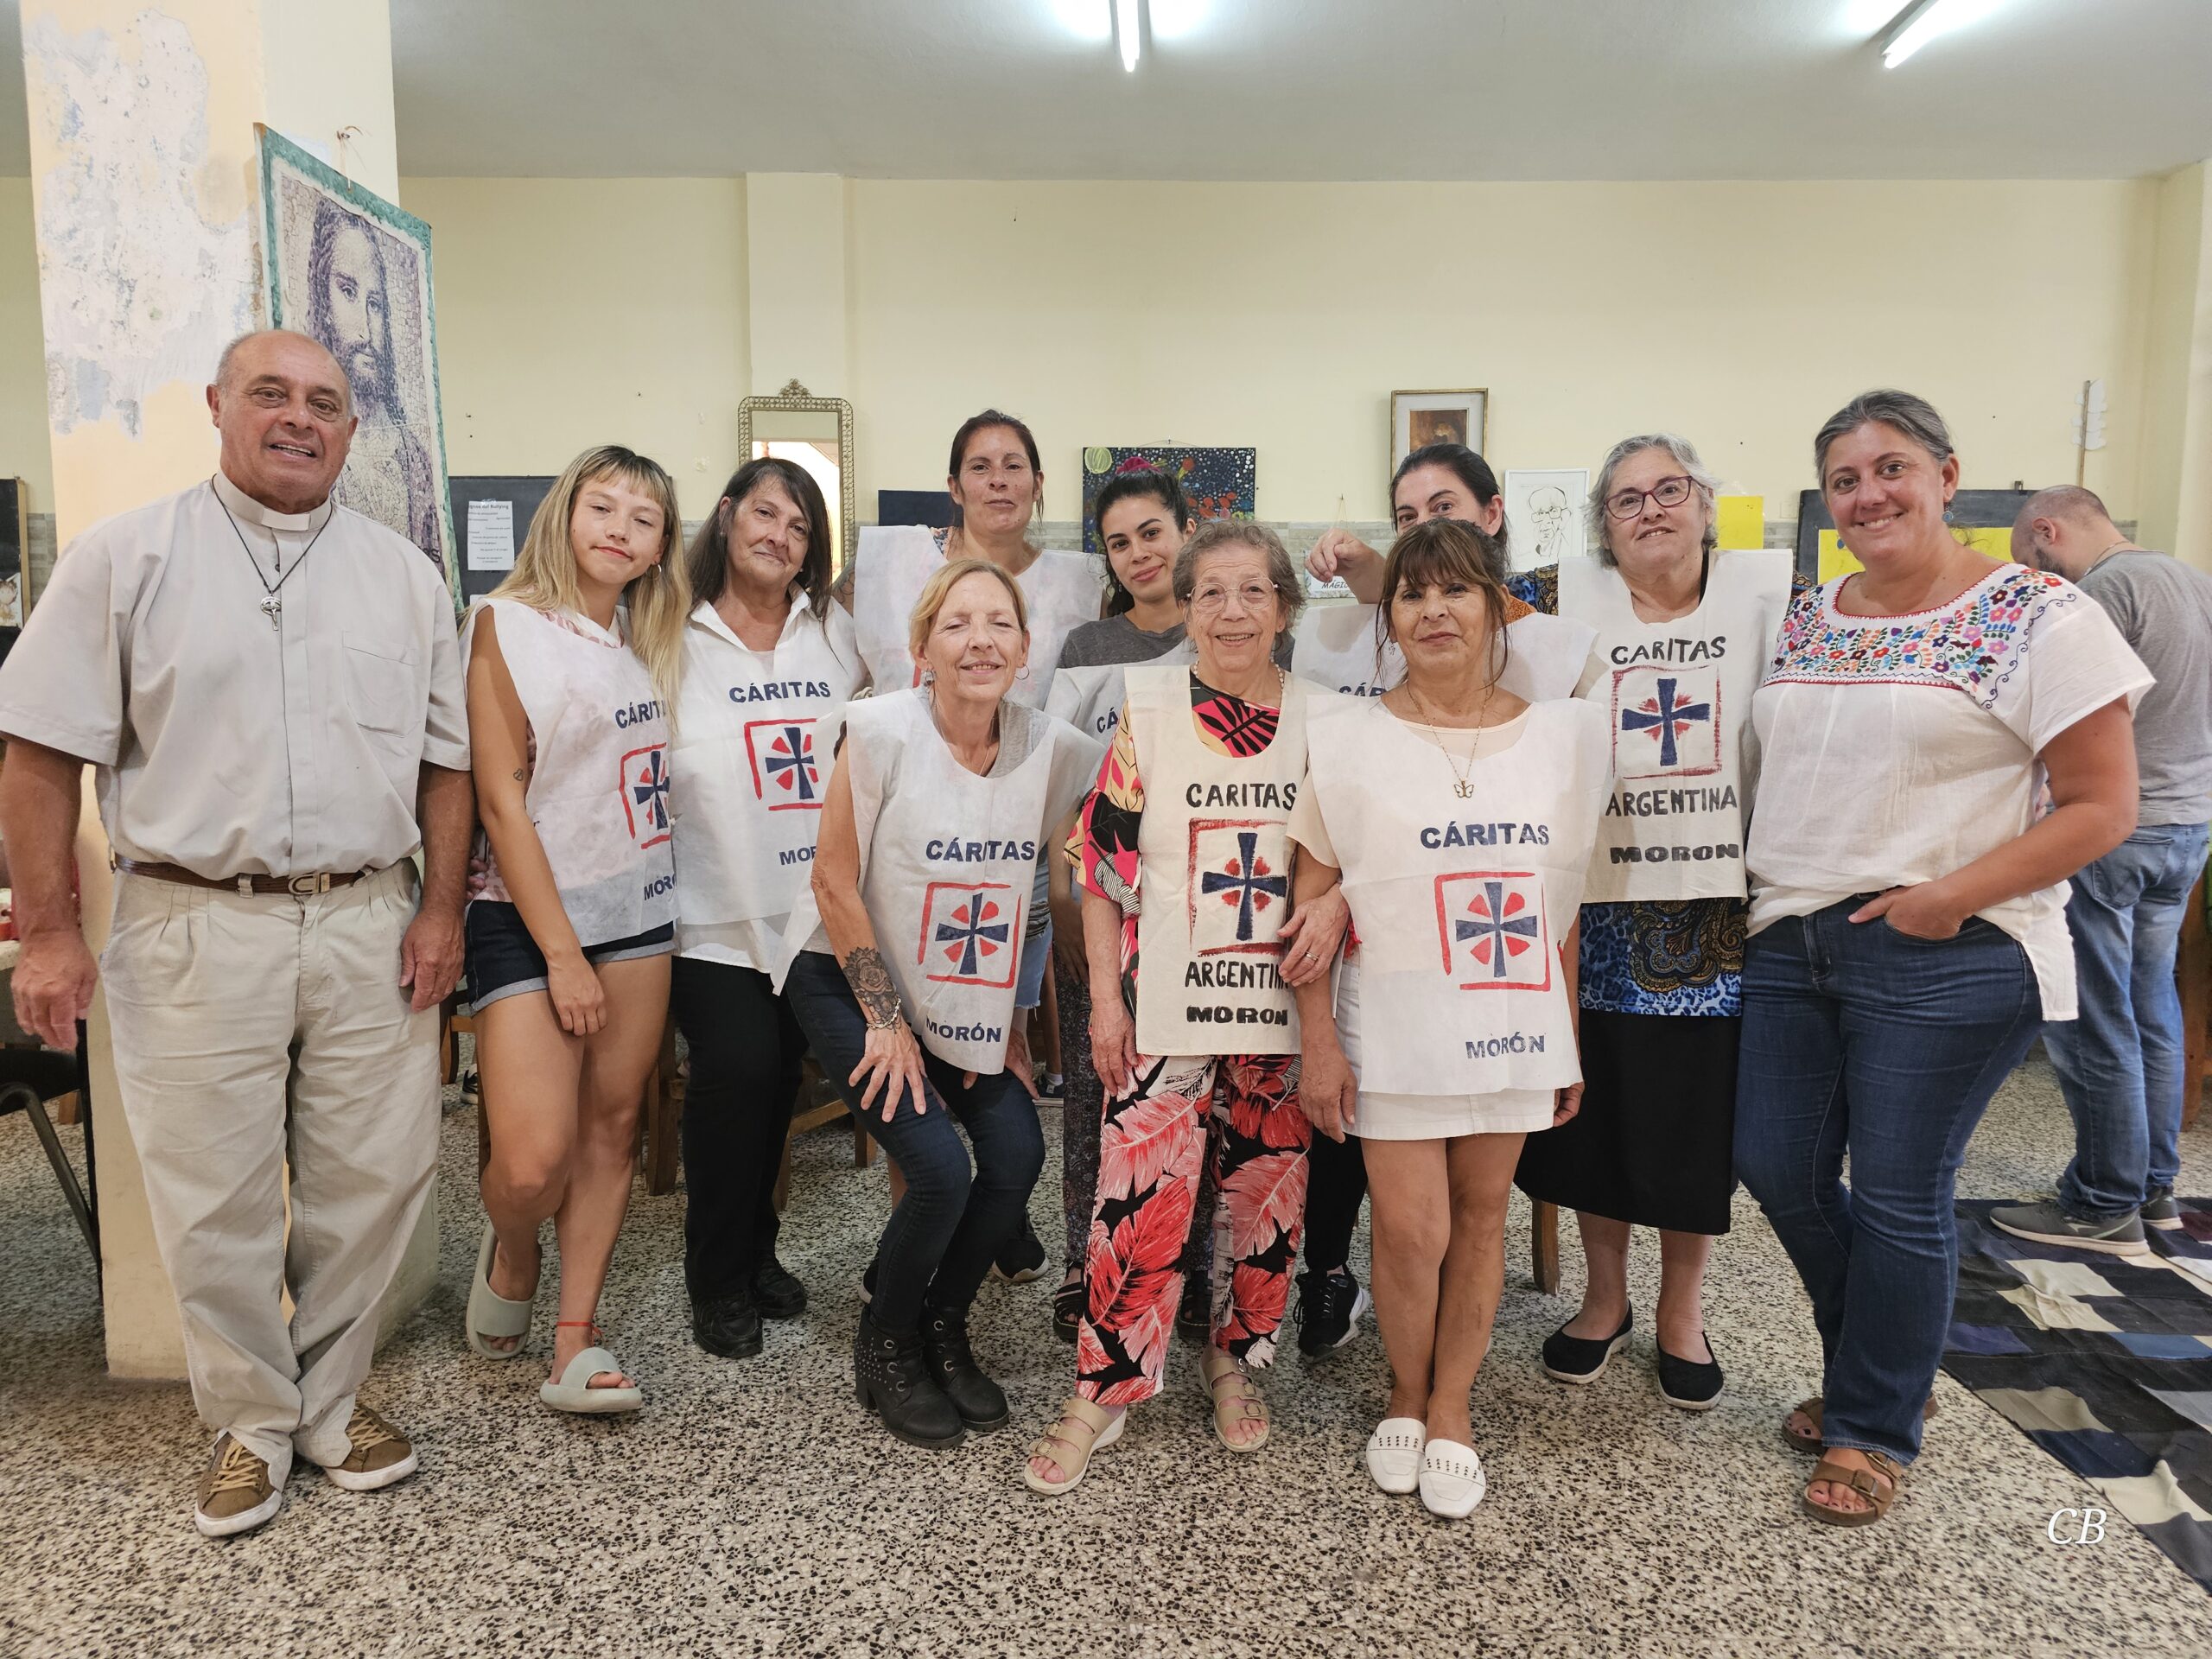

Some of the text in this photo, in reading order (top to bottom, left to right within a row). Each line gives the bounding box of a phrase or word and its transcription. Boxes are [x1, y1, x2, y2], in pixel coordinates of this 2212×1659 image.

[1321, 580, 1348, 589] MÁGIC
[1611, 636, 1726, 664] CARITAS
[729, 681, 830, 702] CÁRITAS
[615, 700, 665, 728] CÁRIT
[1185, 782, 1297, 811] CARITAS
[1605, 785, 1738, 817] ARGENTINA
[1420, 821, 1549, 849] CÁRITAS
[925, 837, 1035, 861] CÁRITAS
[1610, 843, 1740, 864] MORON
[644, 874, 676, 900] MOR
[1185, 960, 1288, 989] ARGENTIN
[1186, 1005, 1288, 1026] MORON
[926, 1018, 1002, 1043] MORÓN
[1465, 1032, 1545, 1058] MORÓN
